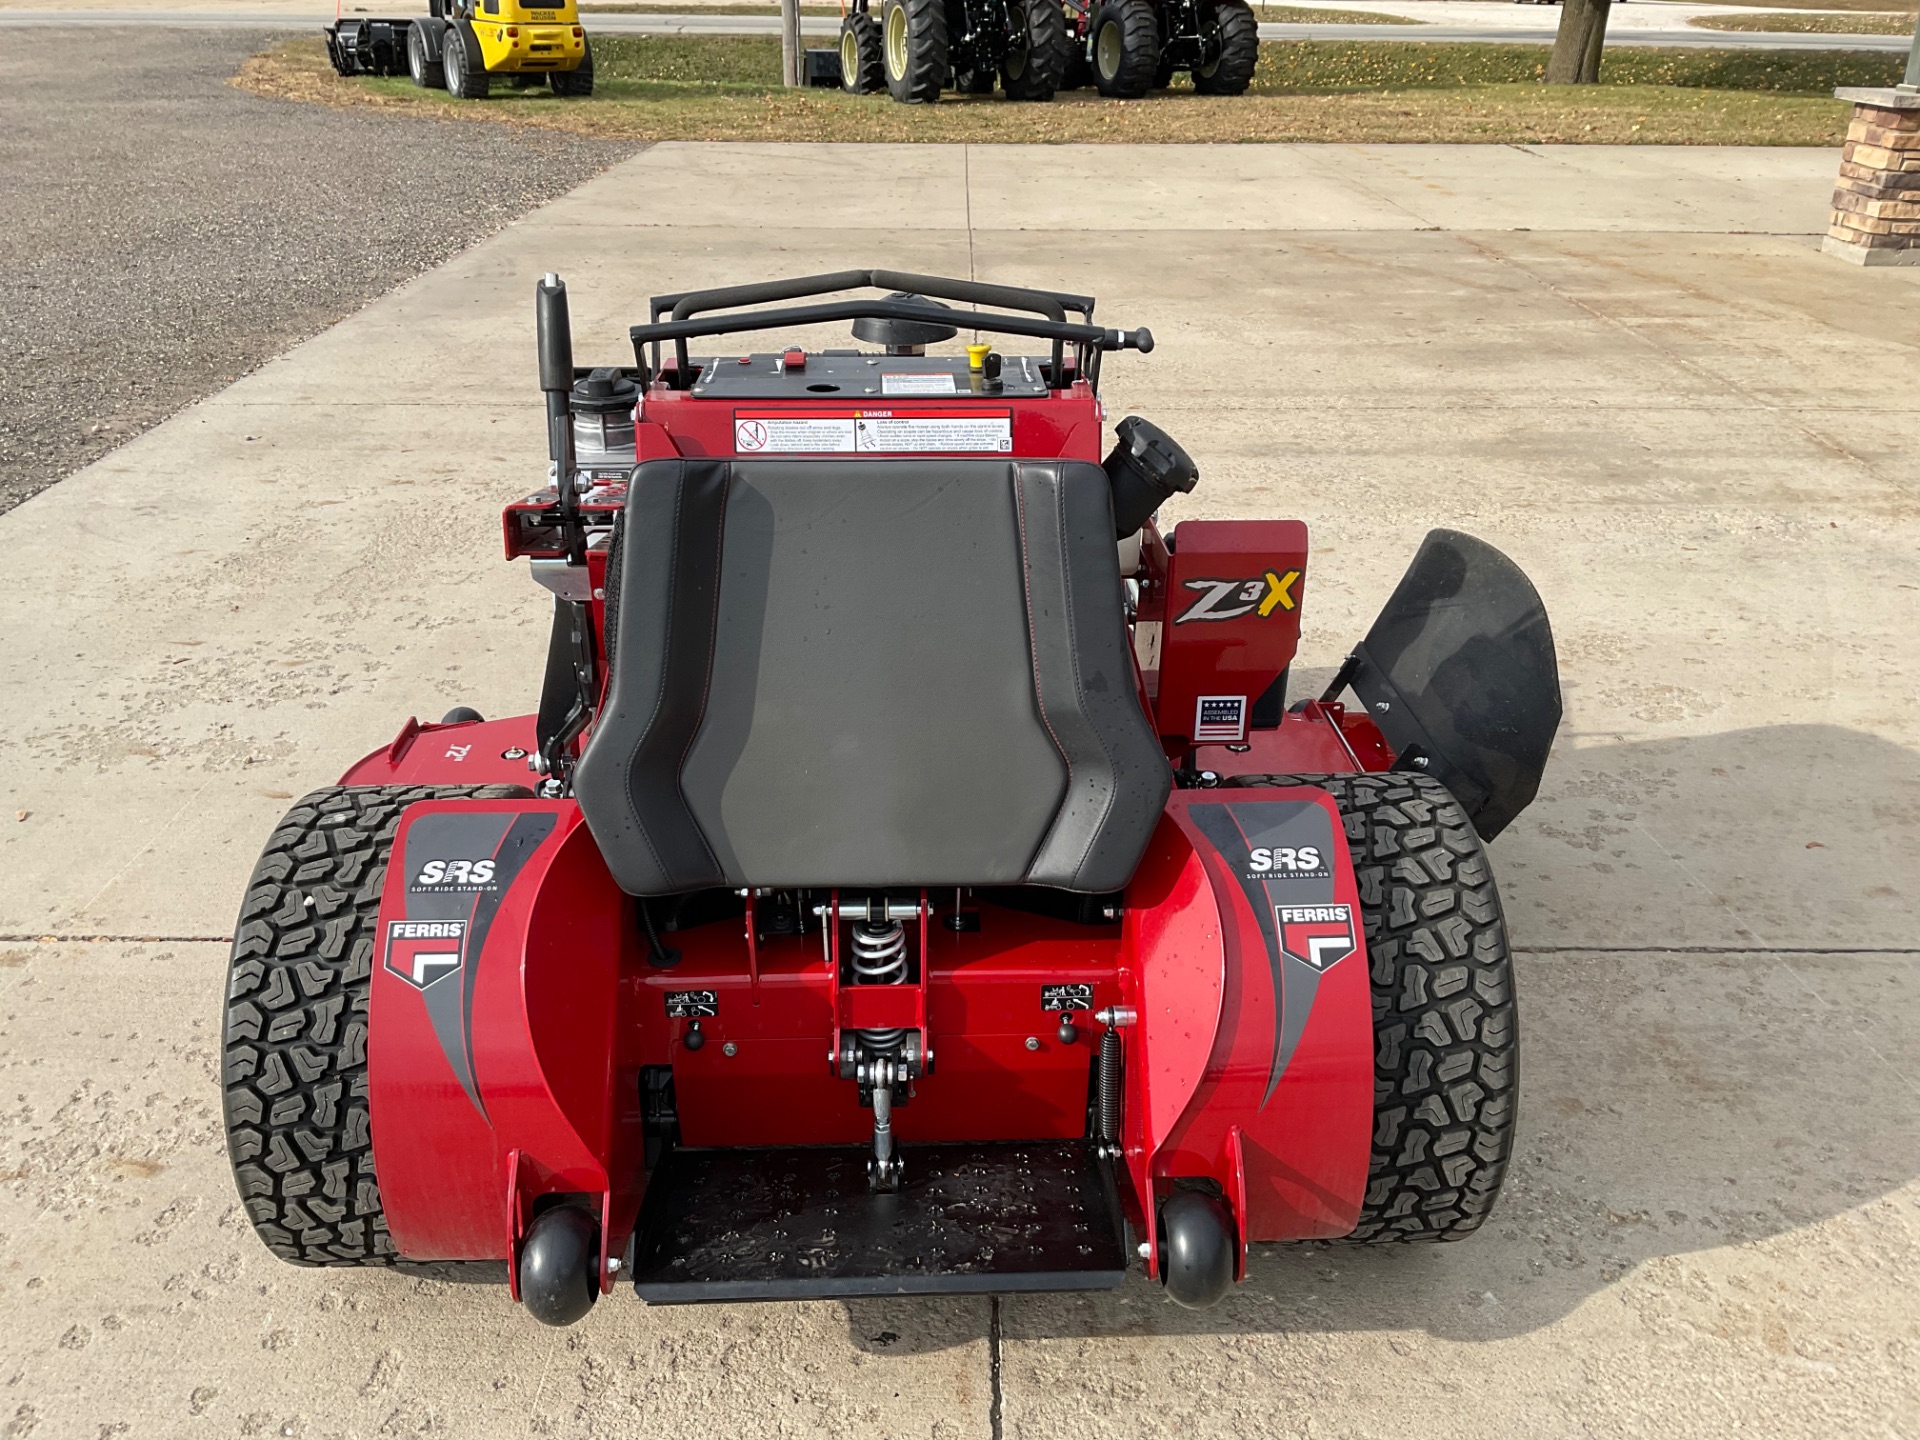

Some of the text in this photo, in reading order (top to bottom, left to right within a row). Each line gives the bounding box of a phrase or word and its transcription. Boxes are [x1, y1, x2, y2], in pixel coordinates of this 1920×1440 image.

[1249, 846, 1320, 872] SRS
[418, 860, 496, 885] SRS
[1281, 907, 1348, 922] FERRIS
[392, 923, 462, 938] FERRIS
